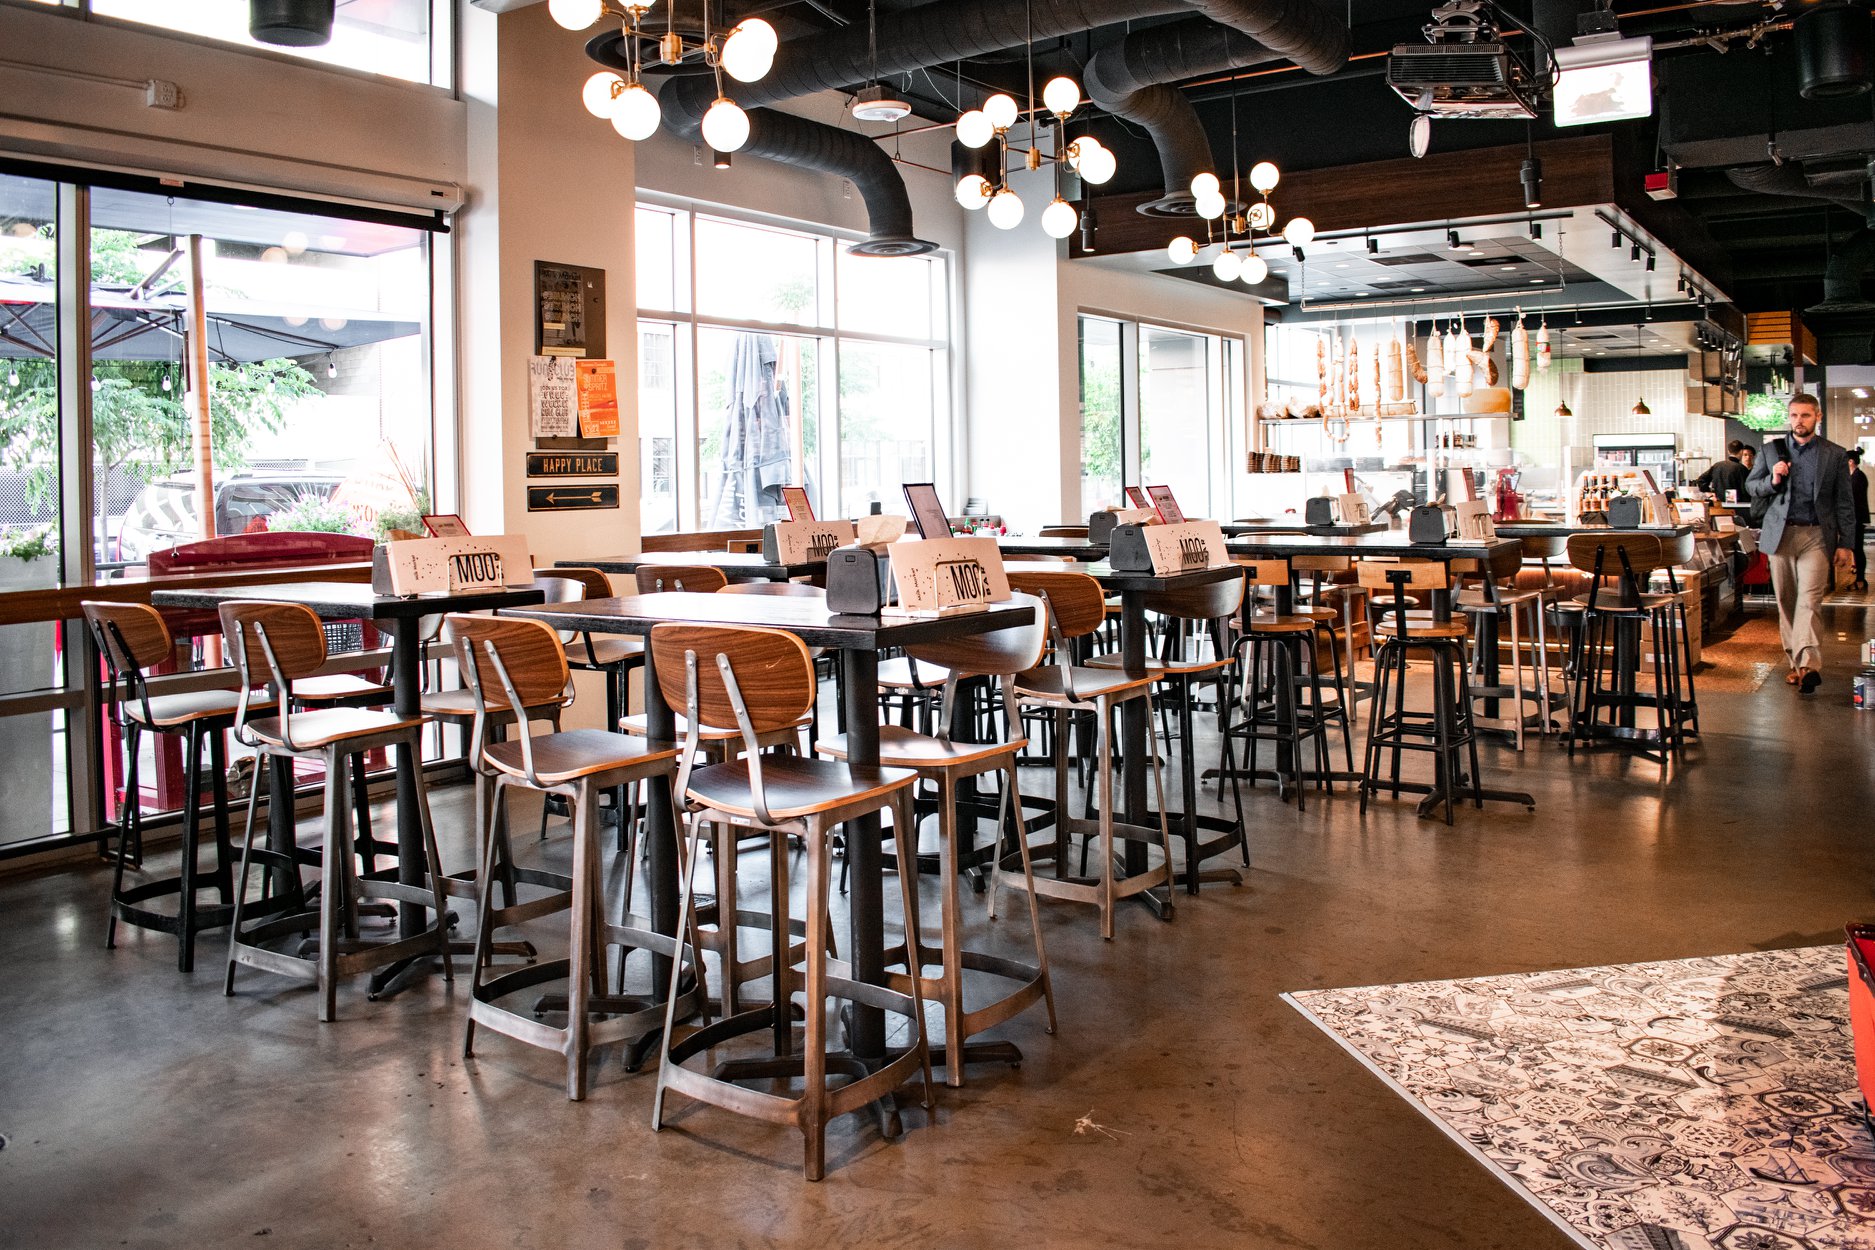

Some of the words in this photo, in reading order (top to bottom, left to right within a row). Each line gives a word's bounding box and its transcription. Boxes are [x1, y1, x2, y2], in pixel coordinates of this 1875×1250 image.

[543, 458, 572, 473] HAPPY
[575, 458, 603, 472] PLACE
[812, 534, 835, 557] MOO
[1179, 538, 1204, 565] MOO
[455, 554, 496, 583] MOO
[950, 563, 985, 600] MOO
[980, 566, 992, 596] BAR
